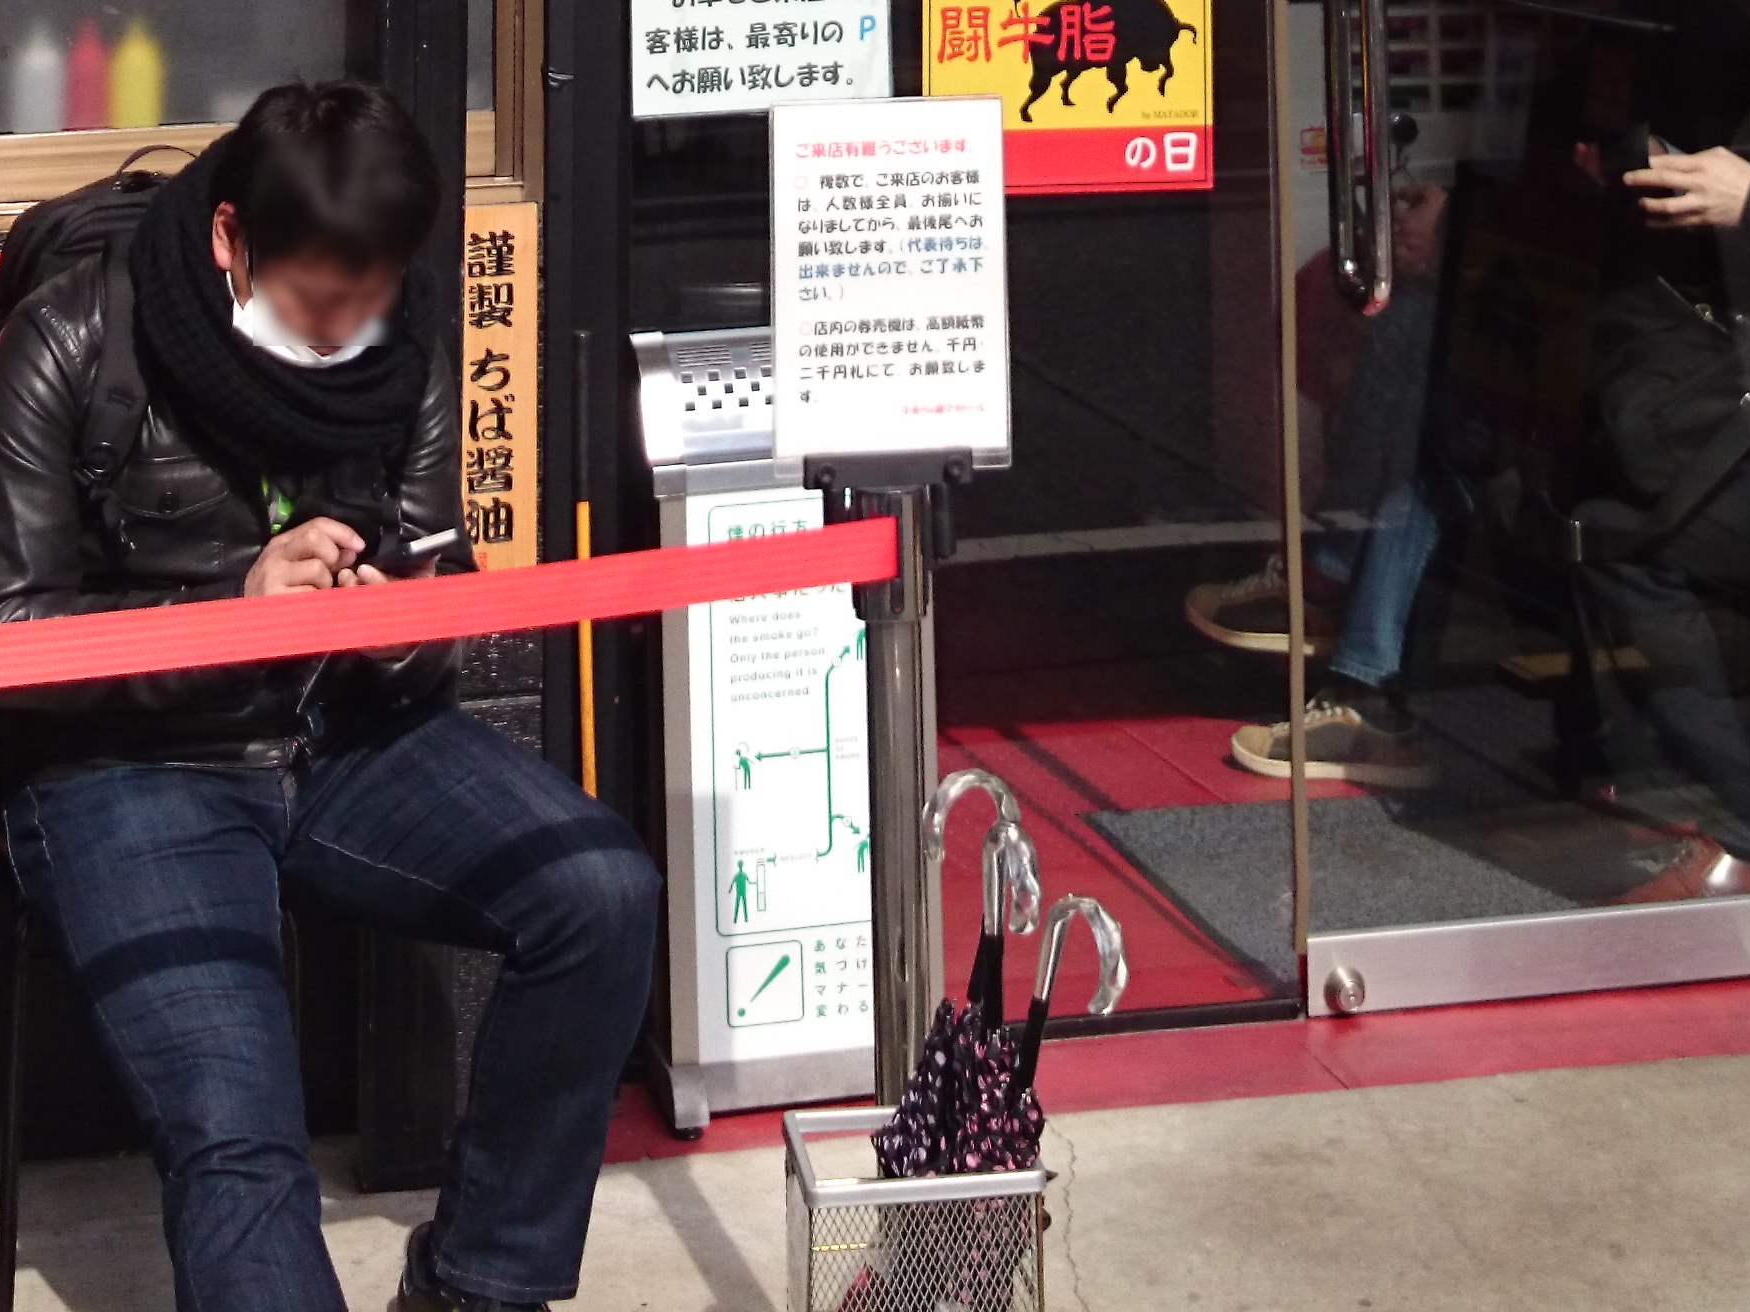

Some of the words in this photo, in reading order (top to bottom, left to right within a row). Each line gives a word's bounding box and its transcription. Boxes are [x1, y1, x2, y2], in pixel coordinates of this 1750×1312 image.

[644, 20, 844, 55] 客様は、最寄りの
[859, 15, 877, 41] P
[937, 0, 1117, 64] 闘牛脂
[646, 60, 853, 94] へお願い致します。
[1153, 108, 1199, 119] MATADOR
[796, 138, 974, 158] ご来店有難うございます。
[1124, 131, 1198, 172] の日
[466, 229, 515, 329] 謹製
[729, 612, 768, 625] Where
[772, 610, 801, 622] does
[730, 633, 748, 644] the
[753, 629, 793, 643] smoke
[730, 651, 757, 665] Only
[761, 648, 780, 661] the
[784, 645, 826, 660] person
[730, 668, 792, 685] producing
[730, 685, 810, 703] unconcerned
